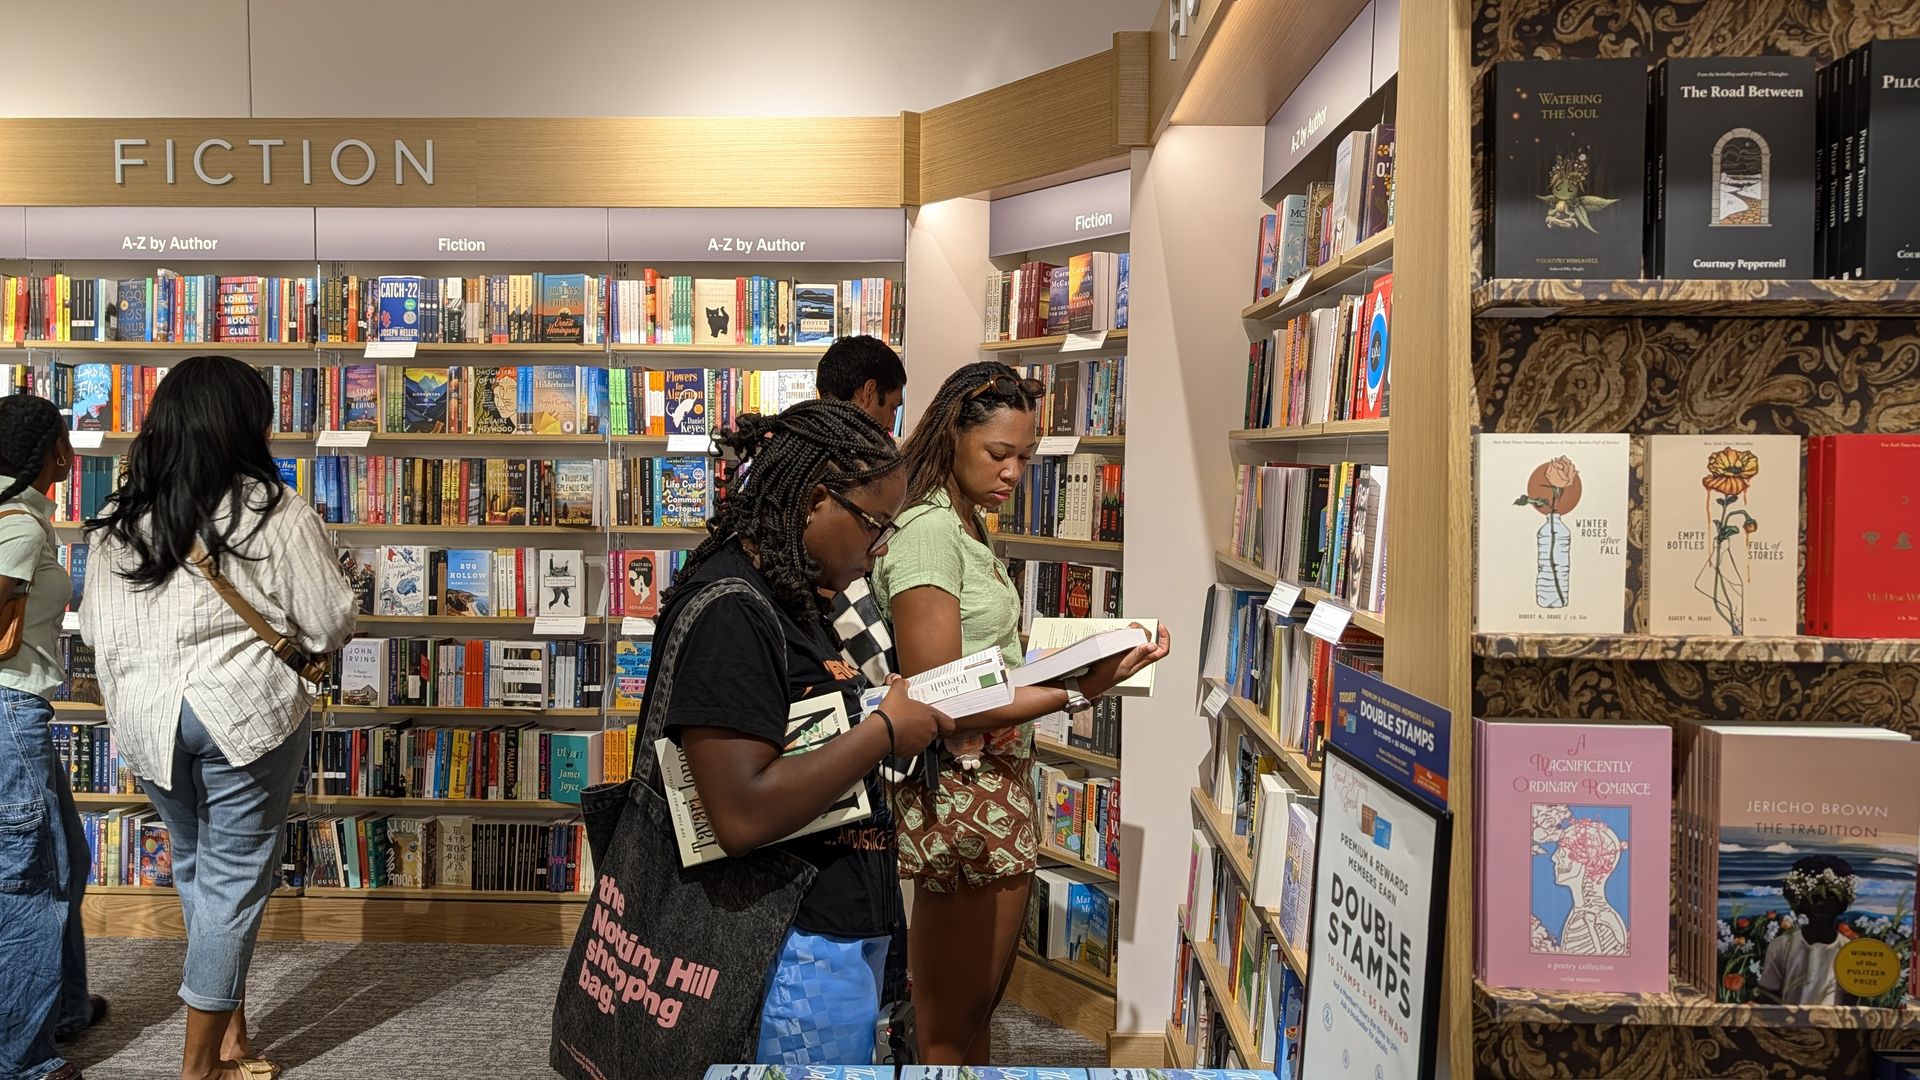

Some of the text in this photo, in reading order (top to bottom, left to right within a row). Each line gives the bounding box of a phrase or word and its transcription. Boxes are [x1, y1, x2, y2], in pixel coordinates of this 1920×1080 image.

[1681, 85, 1804, 98] The Road Between
[1538, 92, 1603, 105] WATERING
[1541, 108, 1600, 119] THE SOUL
[1290, 106, 1328, 155] A-Z by Author
[1859, 129, 1868, 164] PILLOW
[114, 138, 436, 186] FICTION
[1075, 212, 1113, 231] Fiction
[122, 236, 218, 253] A-Z by Author
[438, 238, 486, 251] Fiction
[707, 237, 806, 254] A-Z by Author
[1693, 259, 1786, 270] Courtney Peppernell
[380, 282, 418, 298] CATCH-22
[225, 295, 253, 303] LONELY
[225, 306, 254, 314] HEARTS
[227, 316, 250, 324] BOOK
[555, 317, 574, 327] Ernest
[229, 327, 249, 335] CLUB
[380, 328, 418, 337] JOSEPH HELLER
[546, 324, 580, 336] Hemingway
[548, 371, 562, 379] Elin
[666, 371, 698, 382] Flowers
[535, 380, 575, 388] Hilderbrand
[676, 382, 684, 390] for
[666, 391, 703, 400] Algernon
[687, 417, 705, 425] Daniel
[680, 421, 705, 434] Keyes
[580, 483, 593, 492] SUNS
[682, 480, 704, 489] Cycle
[667, 495, 702, 503] Common
[667, 505, 701, 513] Octopus
[1576, 519, 1608, 528] WINTER
[1581, 529, 1608, 537] ROSES
[1678, 531, 1706, 540] EMPTY
[1600, 536, 1620, 545] after
[1667, 541, 1705, 550] BOTTLES
[1748, 541, 1782, 550] FULL of
[1600, 546, 1620, 555] FALL
[1748, 551, 1784, 560] STORIES
[1068, 597, 1089, 608] LILITH
[348, 647, 373, 655] JOHN
[930, 675, 968, 692] Picoult
[944, 688, 960, 698] Jodi
[1360, 700, 1435, 752] DOUBLE STAMPS
[1567, 734, 1586, 756] A
[557, 746, 583, 759] Ulysses
[507, 747, 515, 786] PALMARES
[1530, 754, 1633, 776] MAGNIFICENTLY
[558, 769, 581, 779] James
[559, 782, 579, 793] Joyce
[1513, 776, 1651, 799] ORDINARY ROMANCE
[1746, 800, 1889, 818] JERICHO BROWN
[1755, 822, 1878, 838] THE TRADITION
[1340, 832, 1409, 896] PREMIUM & REWARDS
[1348, 856, 1397, 907] MEMBERS EARN
[600, 874, 625, 917] the
[1331, 871, 1411, 977] DOUBLE
[592, 904, 719, 1000] Notting Hill
[1851, 950, 1884, 958] WINNER
[1328, 911, 1410, 1019] STAMPS
[1553, 962, 1614, 972] poetry collection
[1846, 968, 1886, 976] PULITZER
[578, 960, 615, 1015] bag.
[585, 938, 683, 1029] shoppng
[1854, 978, 1877, 986] PRIZE
[1327, 953, 1409, 1044] 10 STAMPS $5 REWARD
